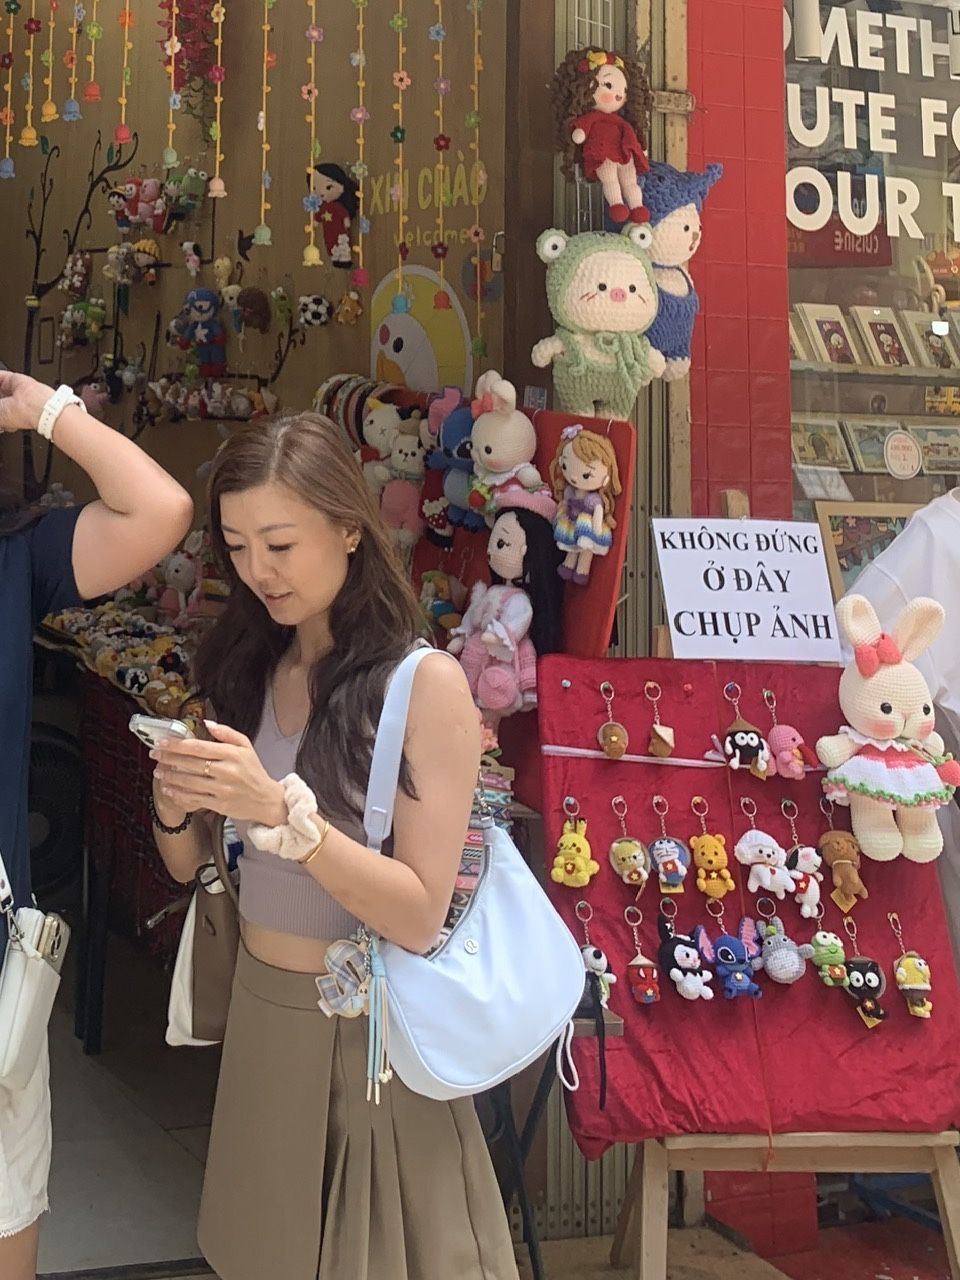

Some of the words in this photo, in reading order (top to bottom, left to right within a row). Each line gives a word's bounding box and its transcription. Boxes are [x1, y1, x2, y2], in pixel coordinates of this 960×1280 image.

[920, 97, 960, 158] F
[369, 168, 409, 217] XIN
[417, 150, 488, 211] CHÀO
[659, 525, 749, 553] KHÔNG
[755, 527, 819, 555] ĐỨNG
[703, 560, 727, 592] Ở
[732, 562, 791, 593] ĐÂY
[673, 609, 762, 644] CHỤP
[770, 605, 834, 640] ẢNH
